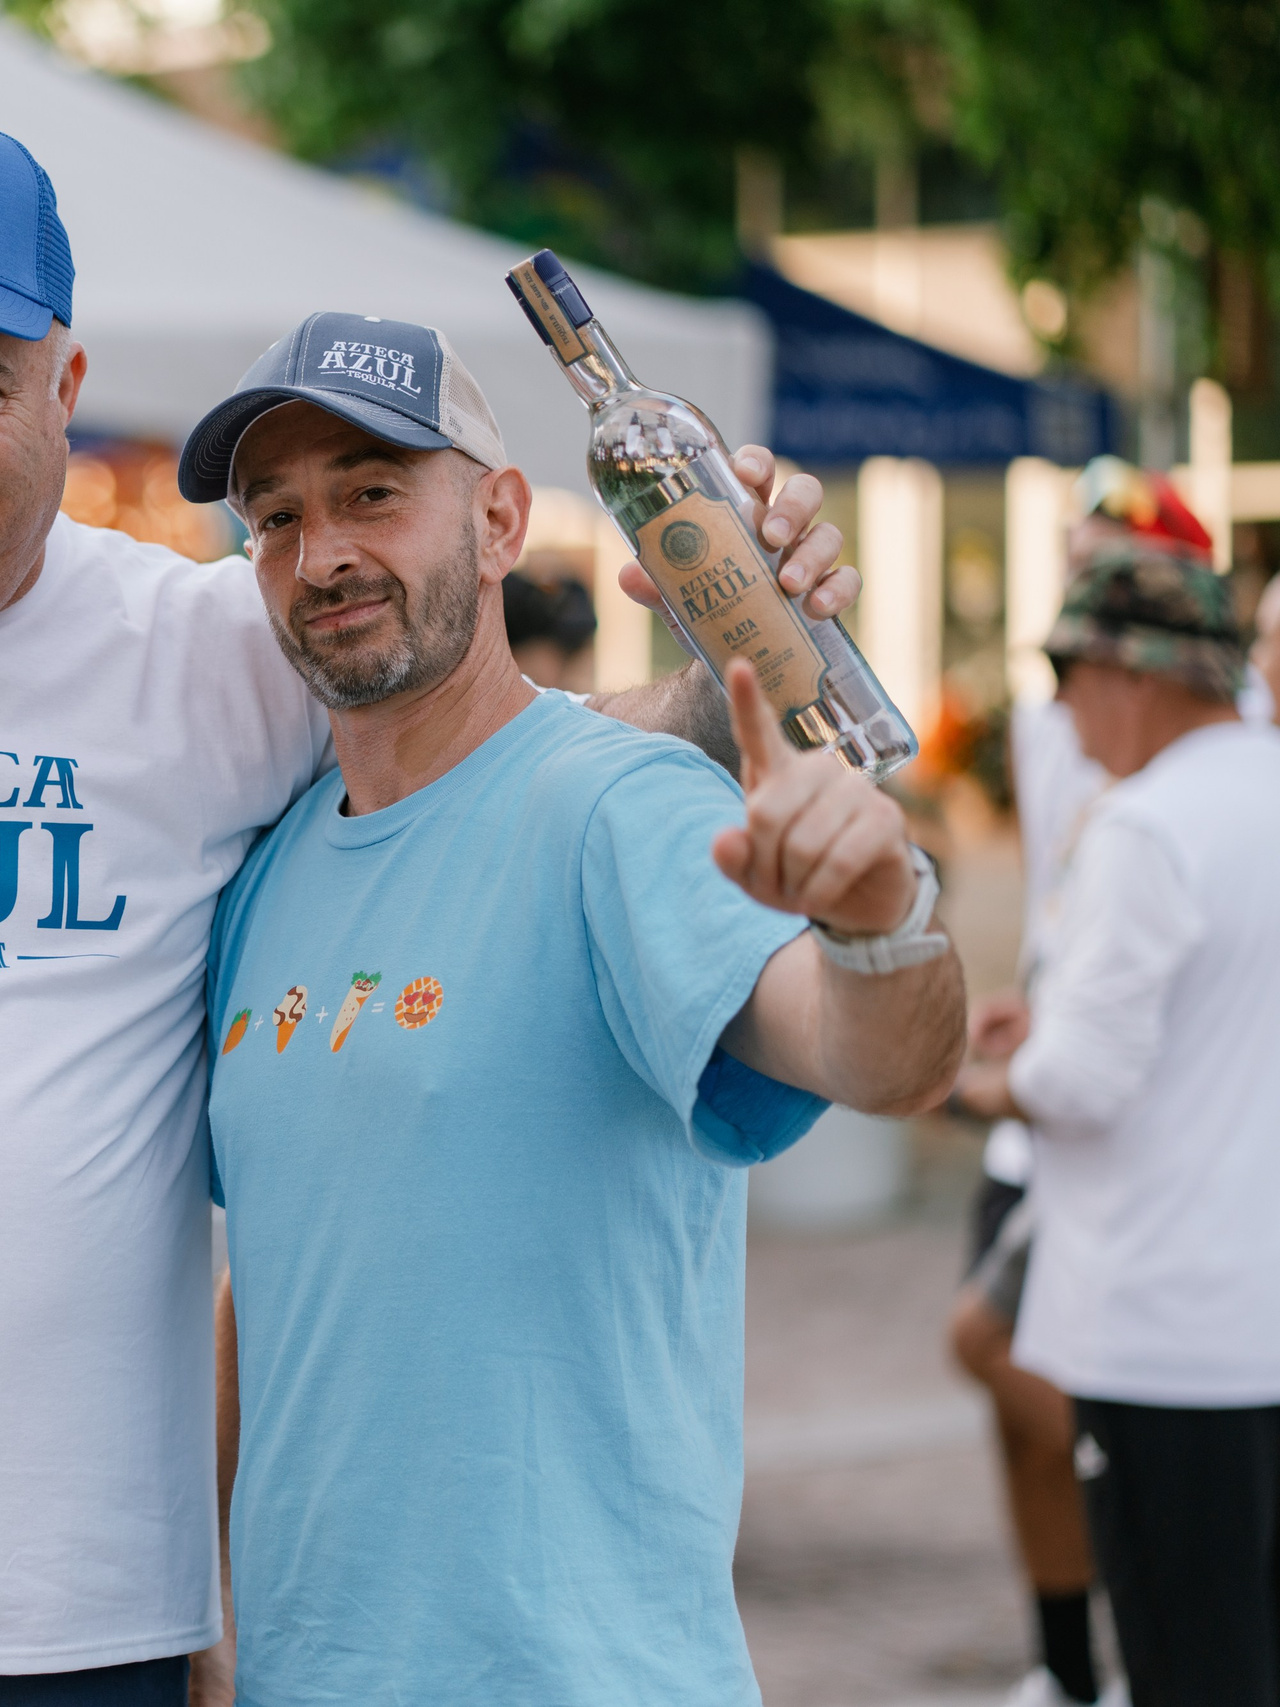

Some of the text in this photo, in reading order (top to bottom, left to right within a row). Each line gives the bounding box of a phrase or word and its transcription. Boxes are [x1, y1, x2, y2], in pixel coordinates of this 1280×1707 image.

[549, 315, 569, 344] TEQUILA
[331, 341, 414, 368] AZTECA
[318, 351, 421, 394] AZUL
[346, 369, 396, 391] TEQUILA
[678, 557, 736, 598] AZTECA
[682, 566, 757, 623] AZUL
[708, 596, 743, 622] TEQUILA
[722, 618, 757, 645] PLATA
